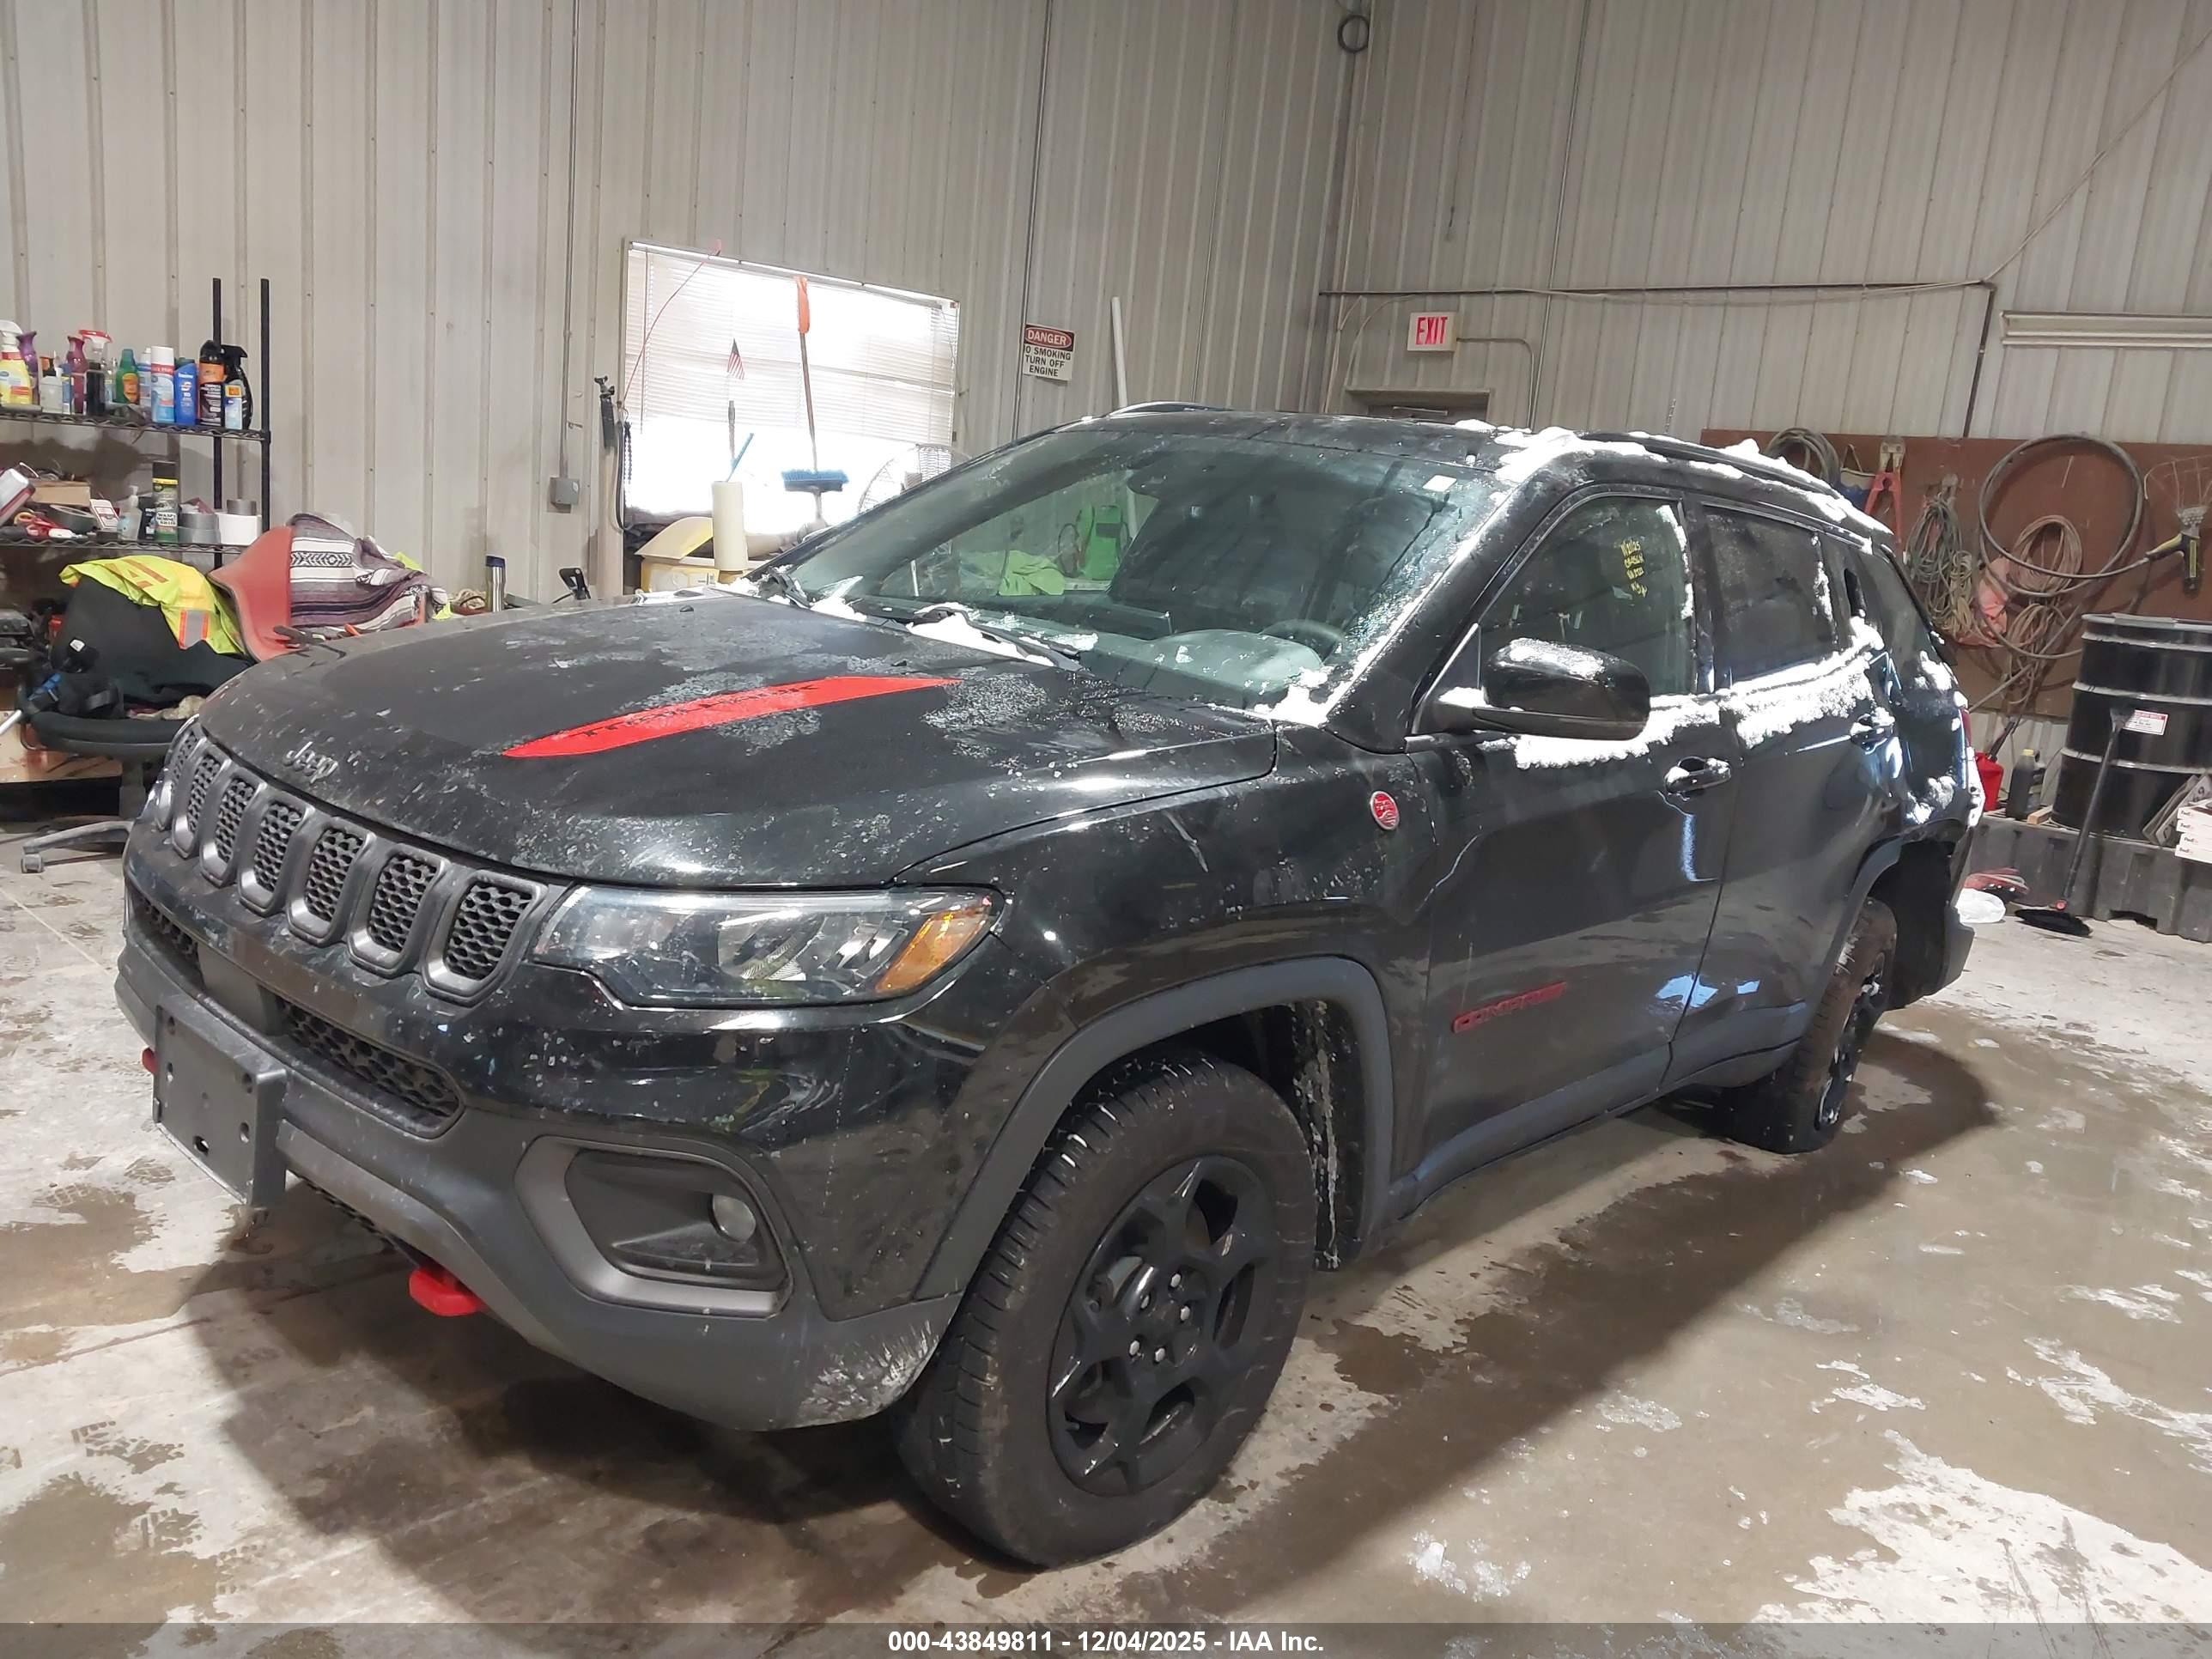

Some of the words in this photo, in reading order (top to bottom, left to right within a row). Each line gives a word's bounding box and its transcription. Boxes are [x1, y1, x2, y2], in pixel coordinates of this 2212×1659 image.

[1027, 330, 1066, 346] DANGER
[1415, 316, 1448, 345] EXIT
[1024, 345, 1031, 354] O
[1033, 347, 1071, 361] SMOKING
[1025, 355, 1047, 366] TURN
[1049, 359, 1065, 368] OFF
[1029, 365, 1059, 377] ENGINE
[282, 741, 338, 784] Jeep
